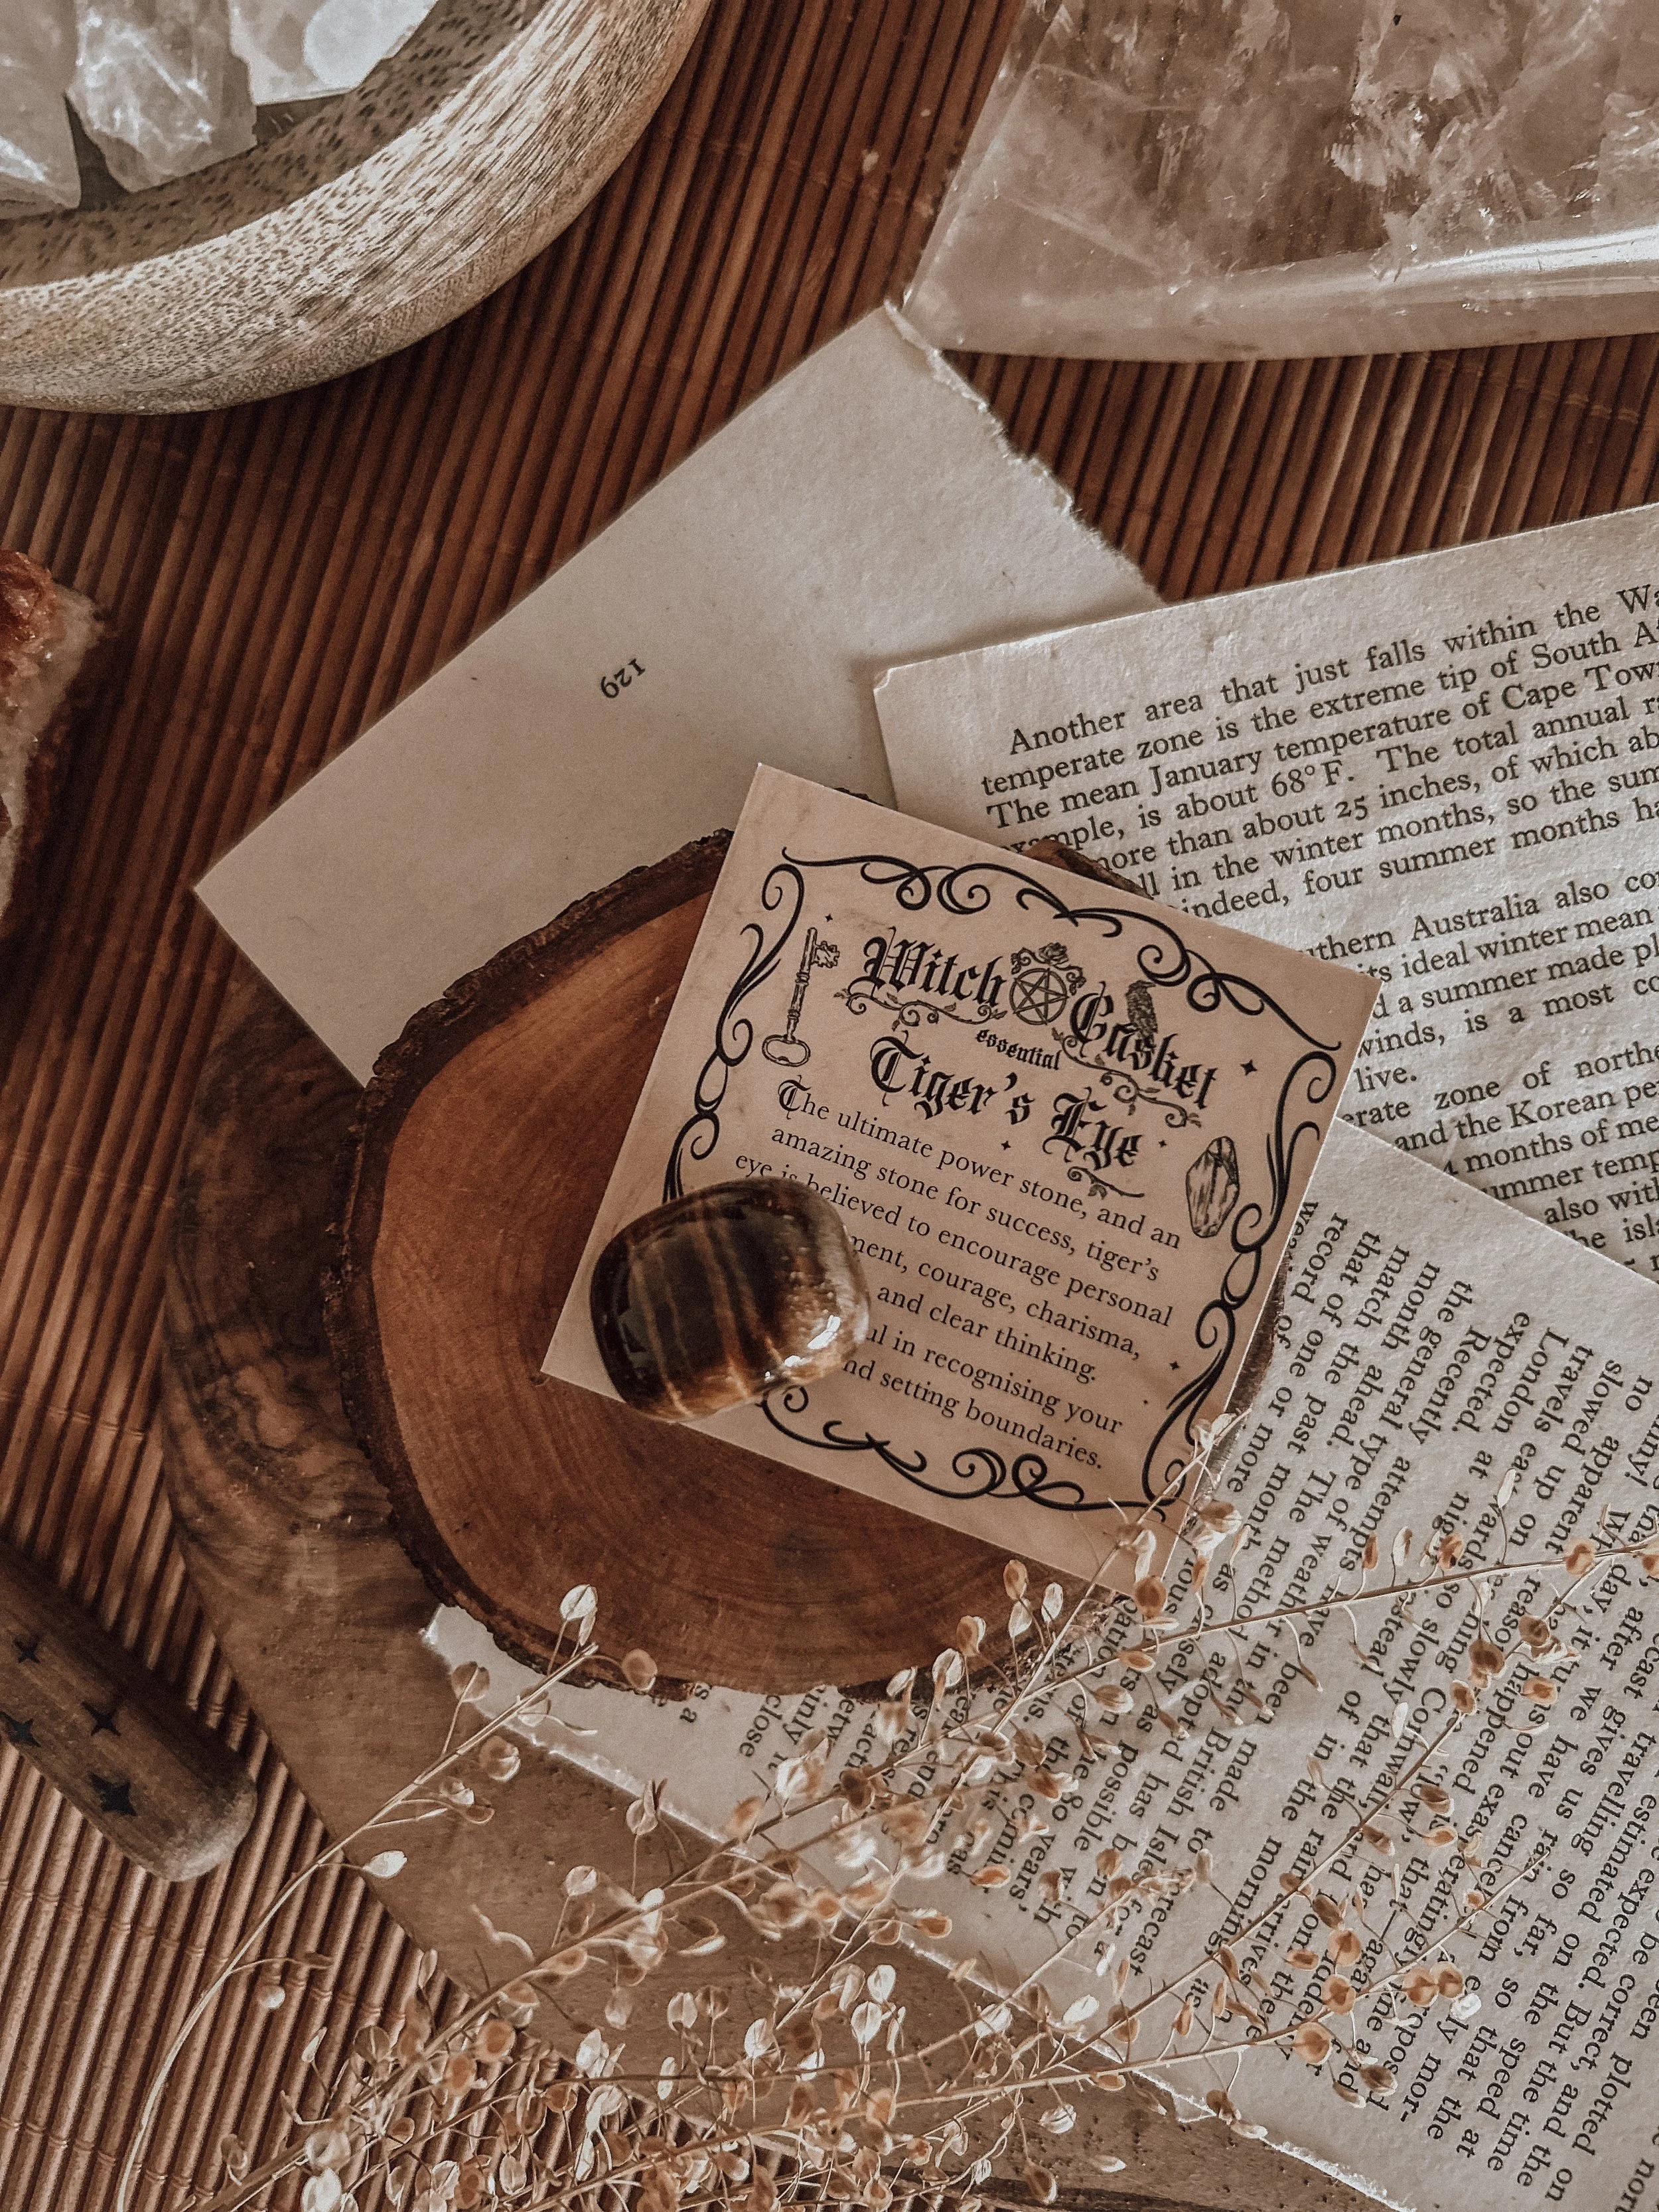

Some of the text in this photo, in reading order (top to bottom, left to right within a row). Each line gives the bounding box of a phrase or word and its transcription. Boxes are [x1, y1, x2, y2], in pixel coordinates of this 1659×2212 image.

[600, 658, 646, 699] 129
[980, 629, 1622, 796] temperate zone is the extreme tip of South
[1009, 601, 1601, 755] Another area that just falls within the
[985, 661, 1659, 829] The mean January temperature of Cape Tow
[1137, 803, 1162, 829] is
[1175, 783, 1258, 820] about
[1375, 743, 1441, 773] The
[1451, 719, 1519, 757] total
[1531, 694, 1631, 739] annual
[1165, 828, 1234, 856] than
[1242, 803, 1325, 840] about
[1334, 794, 1368, 821] 25
[1378, 773, 1480, 809] inches,
[1490, 753, 1520, 783] of
[1528, 735, 1619, 774] which
[1171, 865, 1202, 891] in
[1211, 853, 1260, 881] the
[1269, 832, 1364, 867] winter
[1375, 802, 1496, 845] months,
[1506, 794, 1539, 815] so
[1548, 778, 1596, 805] the
[1302, 866, 1363, 896] four
[1378, 836, 1496, 879] summer
[1509, 806, 1621, 849] months
[1400, 908, 1654, 978] ideal winter mean
[1410, 880, 1610, 942] Australia also
[1421, 967, 1538, 1008] summer
[1546, 944, 1625, 981] made
[1463, 1008, 1490, 1034] is
[1542, 983, 1615, 1017] most
[870, 1029, 1143, 1171] Tiger's Eye
[974, 1027, 1062, 1070] essential
[1353, 1065, 1417, 1093] live.
[1433, 1059, 1551, 1110] zone of
[777, 1074, 1180, 1249] The ultimate power stone, and an
[1450, 1112, 1502, 1140] the
[1506, 1090, 1621, 1129] Korean
[1463, 1117, 1609, 1173] months of
[770, 1128, 1159, 1282] amazing stone for success, tiger's
[1290, 1212, 1348, 1304] record
[1543, 1196, 1599, 1226] also
[907, 1215, 930, 1236] to
[938, 1229, 1060, 1286] encourage
[1063, 1276, 1173, 1327] personal
[918, 1262, 1139, 1361] courage, charisma,
[877, 1286, 924, 1315] and
[928, 1303, 989, 1338] clear
[994, 1326, 1096, 1384] thinking.
[892, 1330, 915, 1357] in
[922, 1348, 1061, 1417] recognising
[1063, 1402, 1123, 1434] your
[1226, 1230, 1381, 1493] that one more
[1451, 1311, 1530, 1433] expected.
[879, 1372, 960, 1418] setting
[965, 1396, 1102, 1469] boundaries.
[1546, 1374, 1652, 1556] no apparent
[1559, 1359, 1624, 1456] slowed
[1073, 1244, 1410, 1852] match the past possible
[1128, 1260, 1440, 1820] month ahead. The has
[1165, 1280, 1473, 1816] the general type British
[1208, 1324, 1492, 1812] Recently made
[1281, 1326, 1569, 1822] London the
[1348, 1345, 1595, 1769] travels slowly that
[739, 1694, 782, 1757] close
[1528, 1606, 1644, 1799] after have
[1400, 1704, 1626, 2122] gives mor-
[1426, 1732, 1656, 2140] travelling far, that the
[1455, 1794, 1658, 2158] estimated the speed at
[1486, 1869, 1655, 2172] expected. But the time
[1516, 1973, 1636, 2187] correct, and the
[1544, 2051, 1632, 2201] plotted on
